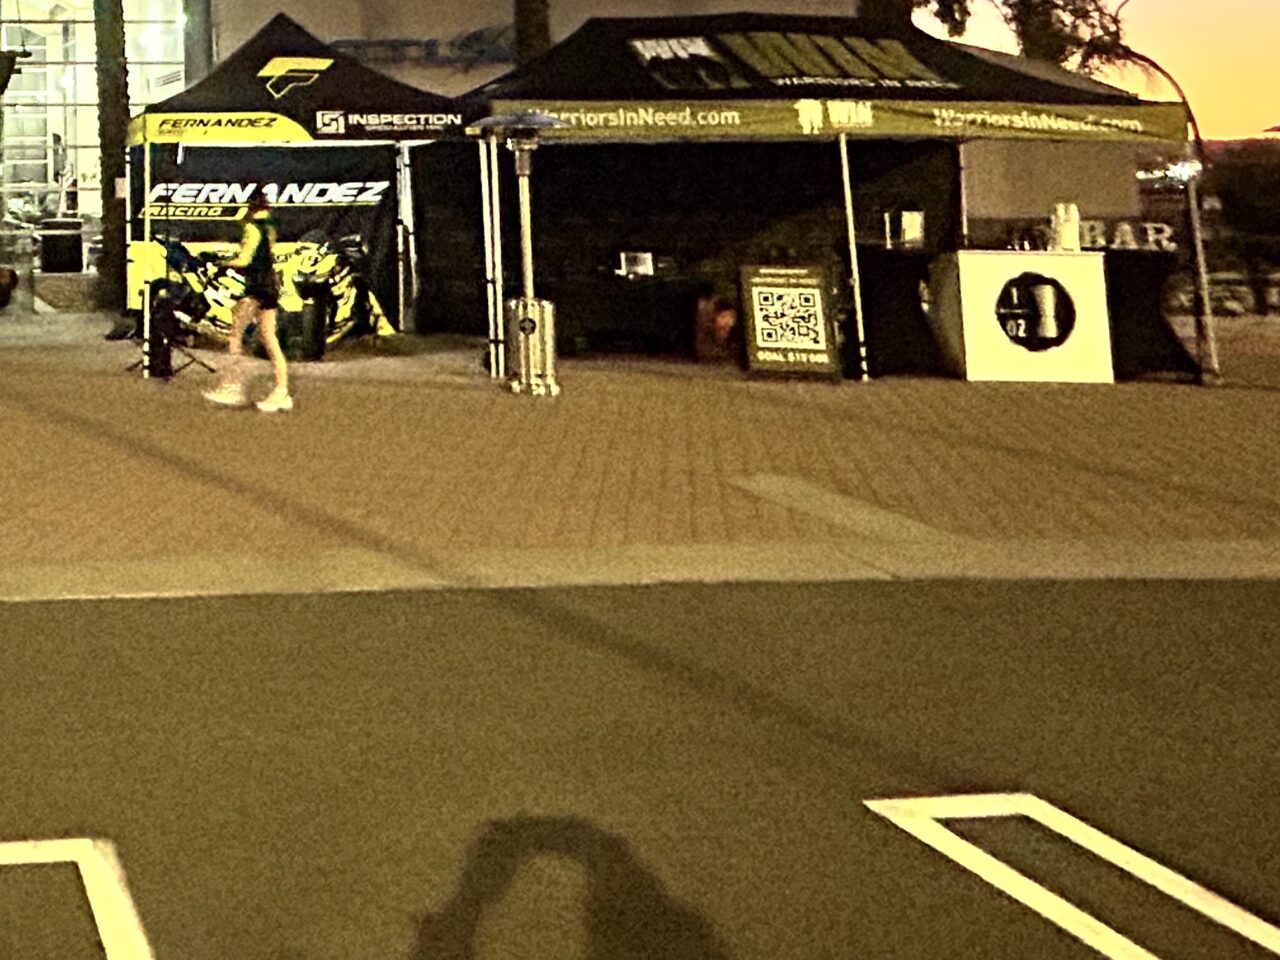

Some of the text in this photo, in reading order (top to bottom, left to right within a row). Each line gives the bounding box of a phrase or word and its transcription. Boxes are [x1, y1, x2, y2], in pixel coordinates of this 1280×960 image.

[158, 117, 278, 129] FERNANDEZ
[348, 114, 462, 126] INSPECTION
[1081, 220, 1178, 250] BAR
